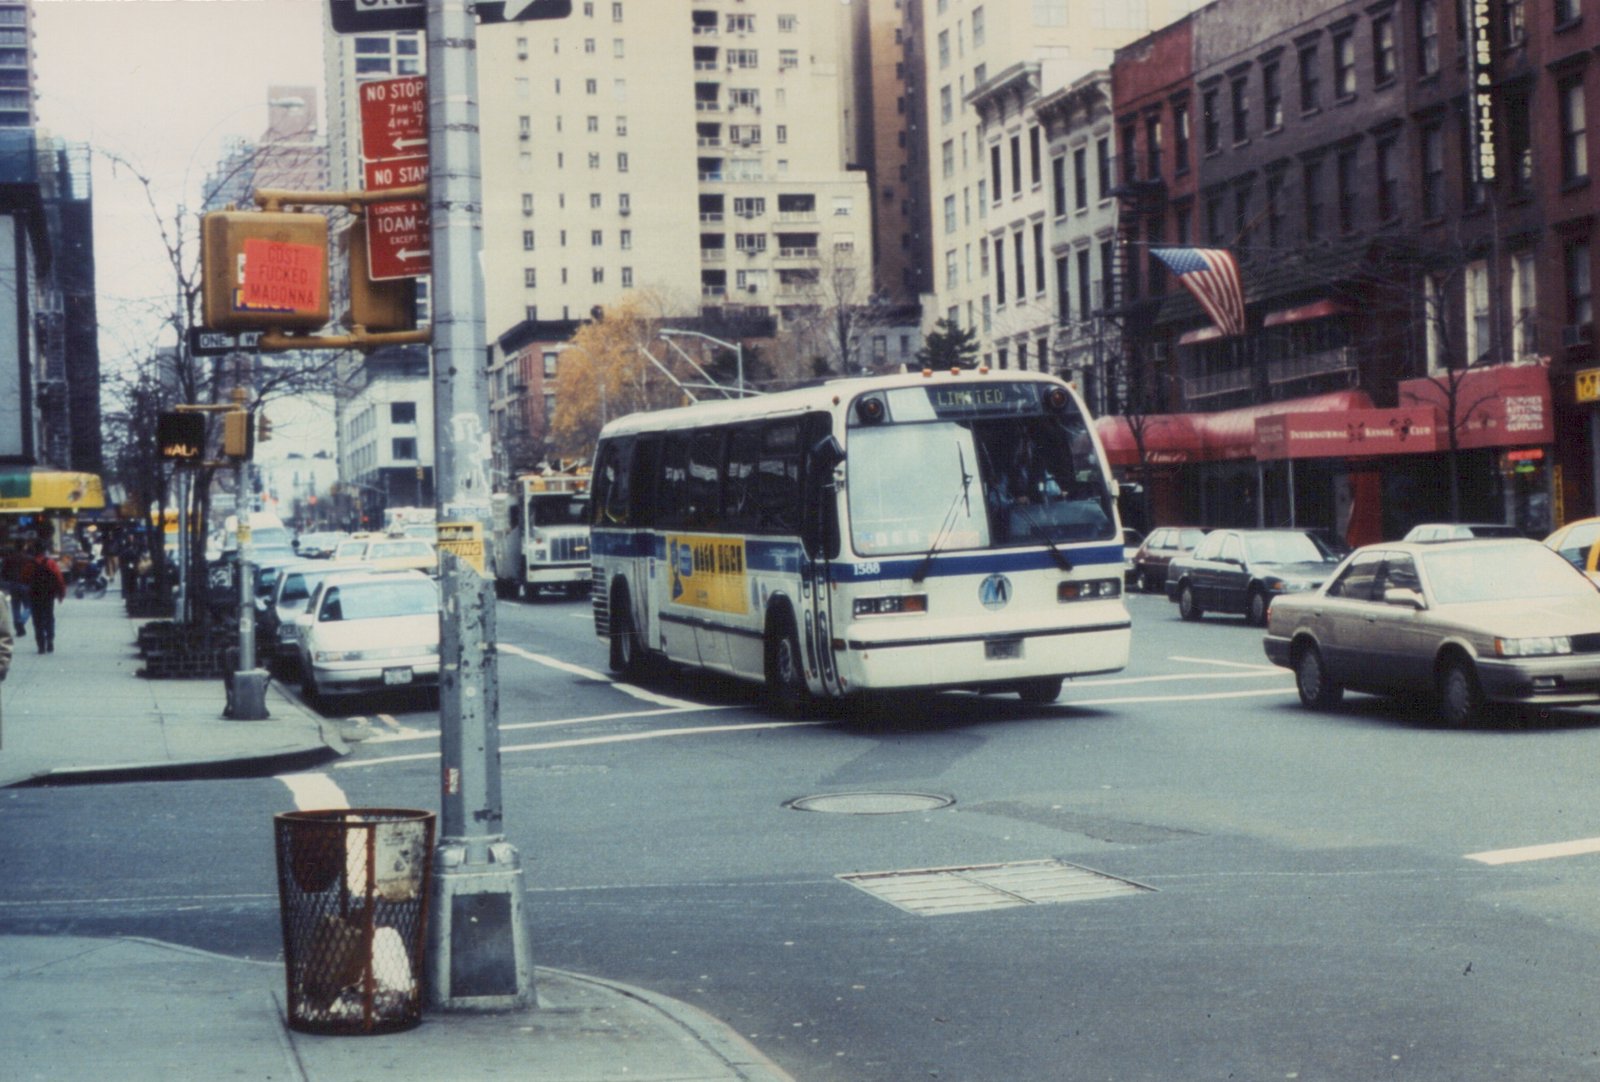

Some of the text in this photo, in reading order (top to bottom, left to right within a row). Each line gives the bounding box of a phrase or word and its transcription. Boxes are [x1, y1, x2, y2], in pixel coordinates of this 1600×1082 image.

[1475, 0, 1491, 64] PPIES
[366, 84, 386, 102] NO
[1477, 94, 1495, 179] KITTENS
[374, 169, 393, 185] NO
[390, 234, 418, 245] EXCEPT
[268, 244, 300, 265] COST
[259, 264, 308, 285] FUCKED
[250, 283, 314, 305] MADONNA
[201, 334, 227, 347] ONE
[853, 562, 881, 576] 1588
